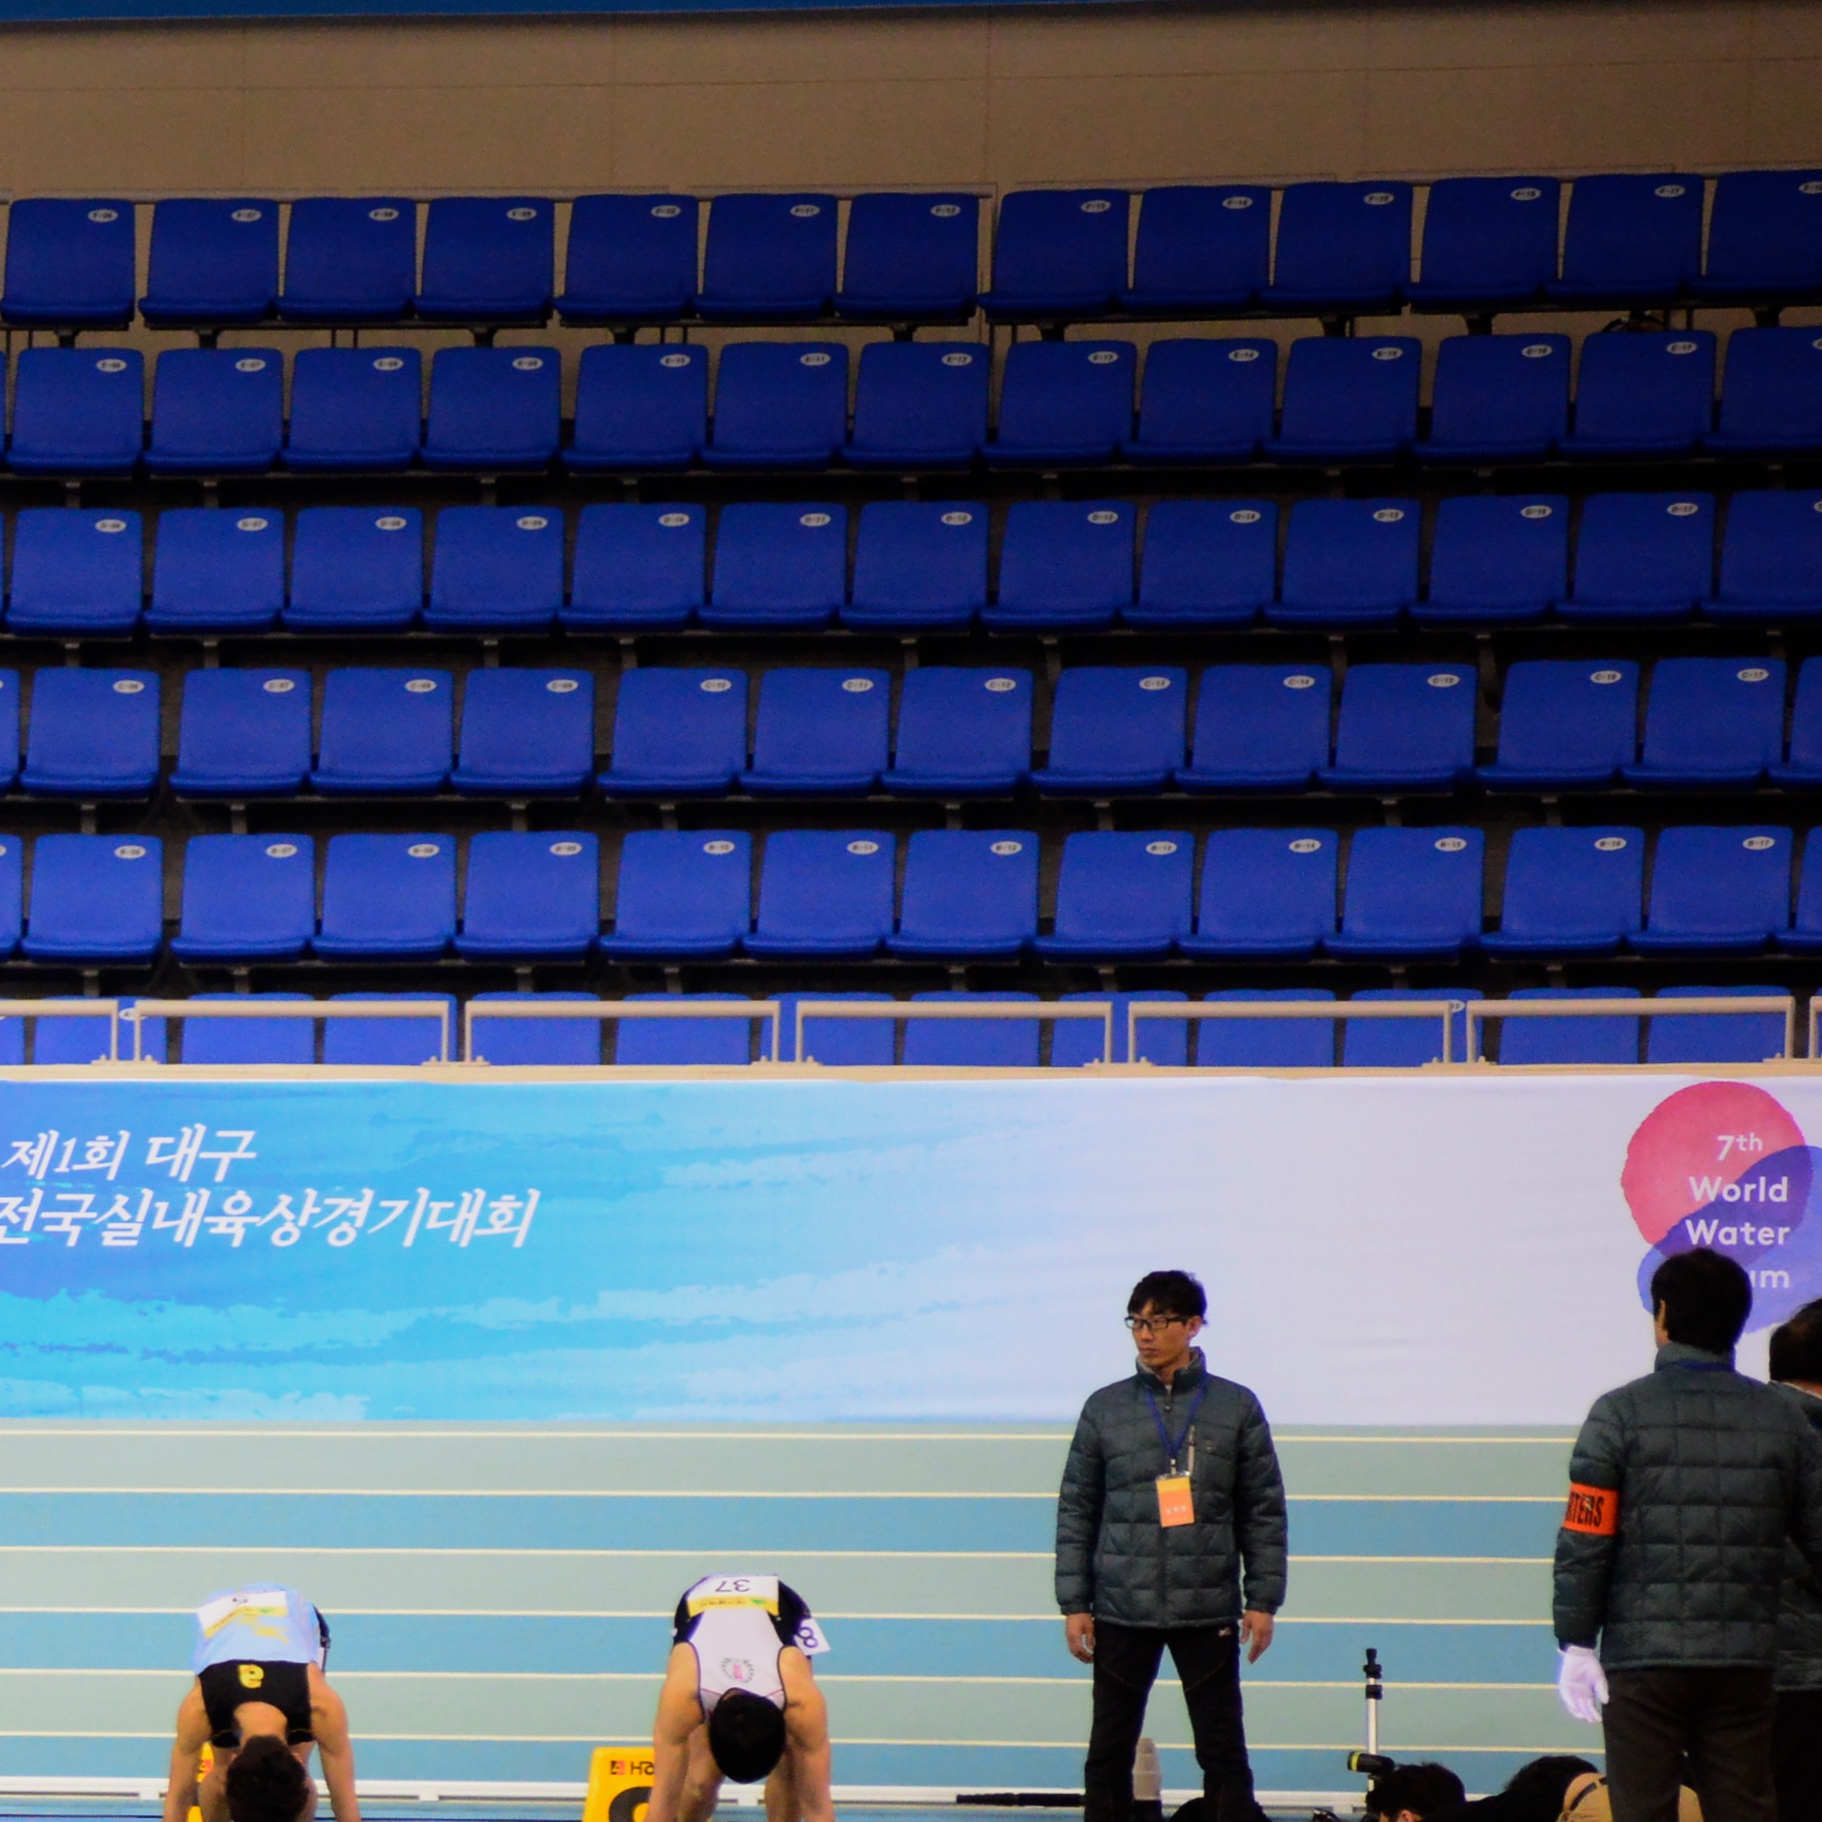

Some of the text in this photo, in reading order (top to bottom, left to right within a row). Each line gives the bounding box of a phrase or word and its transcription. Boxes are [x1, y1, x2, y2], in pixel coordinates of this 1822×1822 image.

[1, 1122, 256, 1183] 제1회 대구
[1717, 1132, 1764, 1161] 7th
[1688, 1176, 1789, 1203] World
[1685, 1218, 1791, 1246] Water
[714, 1578, 751, 1593] 37
[799, 1625, 819, 1650] 8
